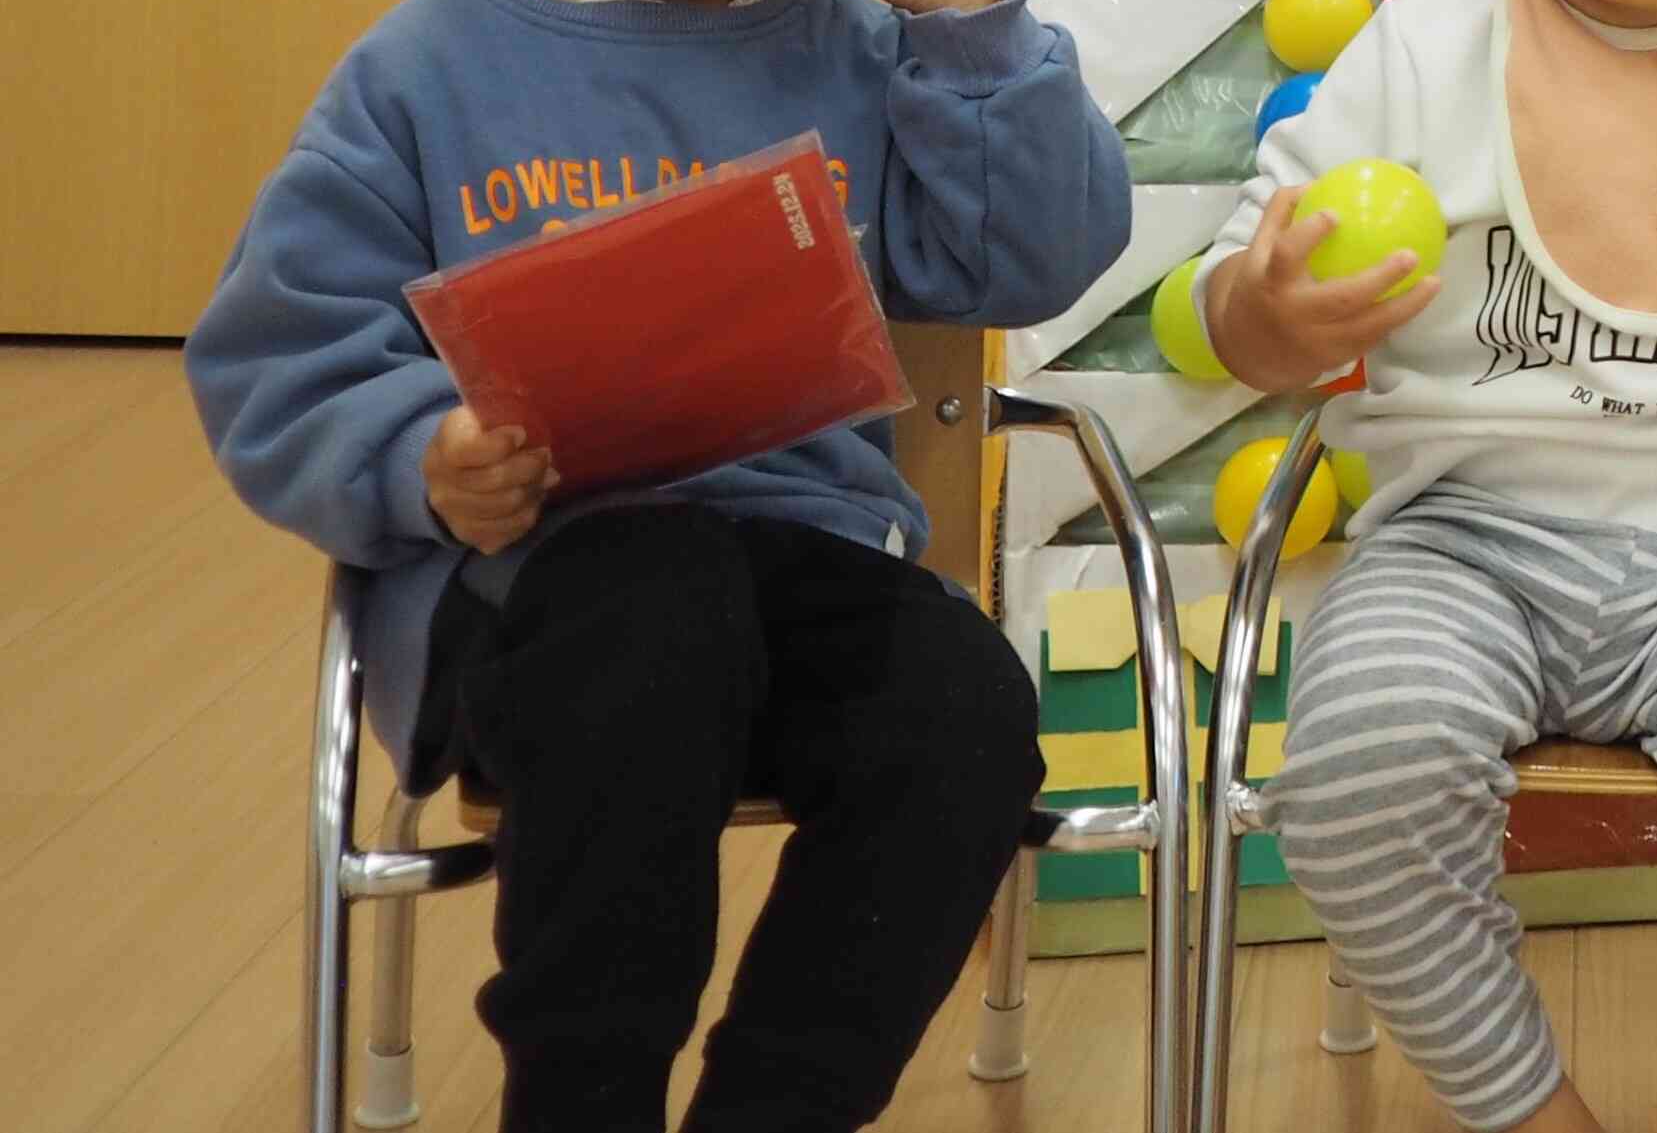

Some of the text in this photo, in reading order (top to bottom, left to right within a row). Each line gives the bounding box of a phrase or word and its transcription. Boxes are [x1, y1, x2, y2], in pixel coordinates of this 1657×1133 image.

[459, 155, 641, 236] LOWELL
[1569, 384, 1594, 405] DO
[1601, 396, 1646, 416] WHAT
